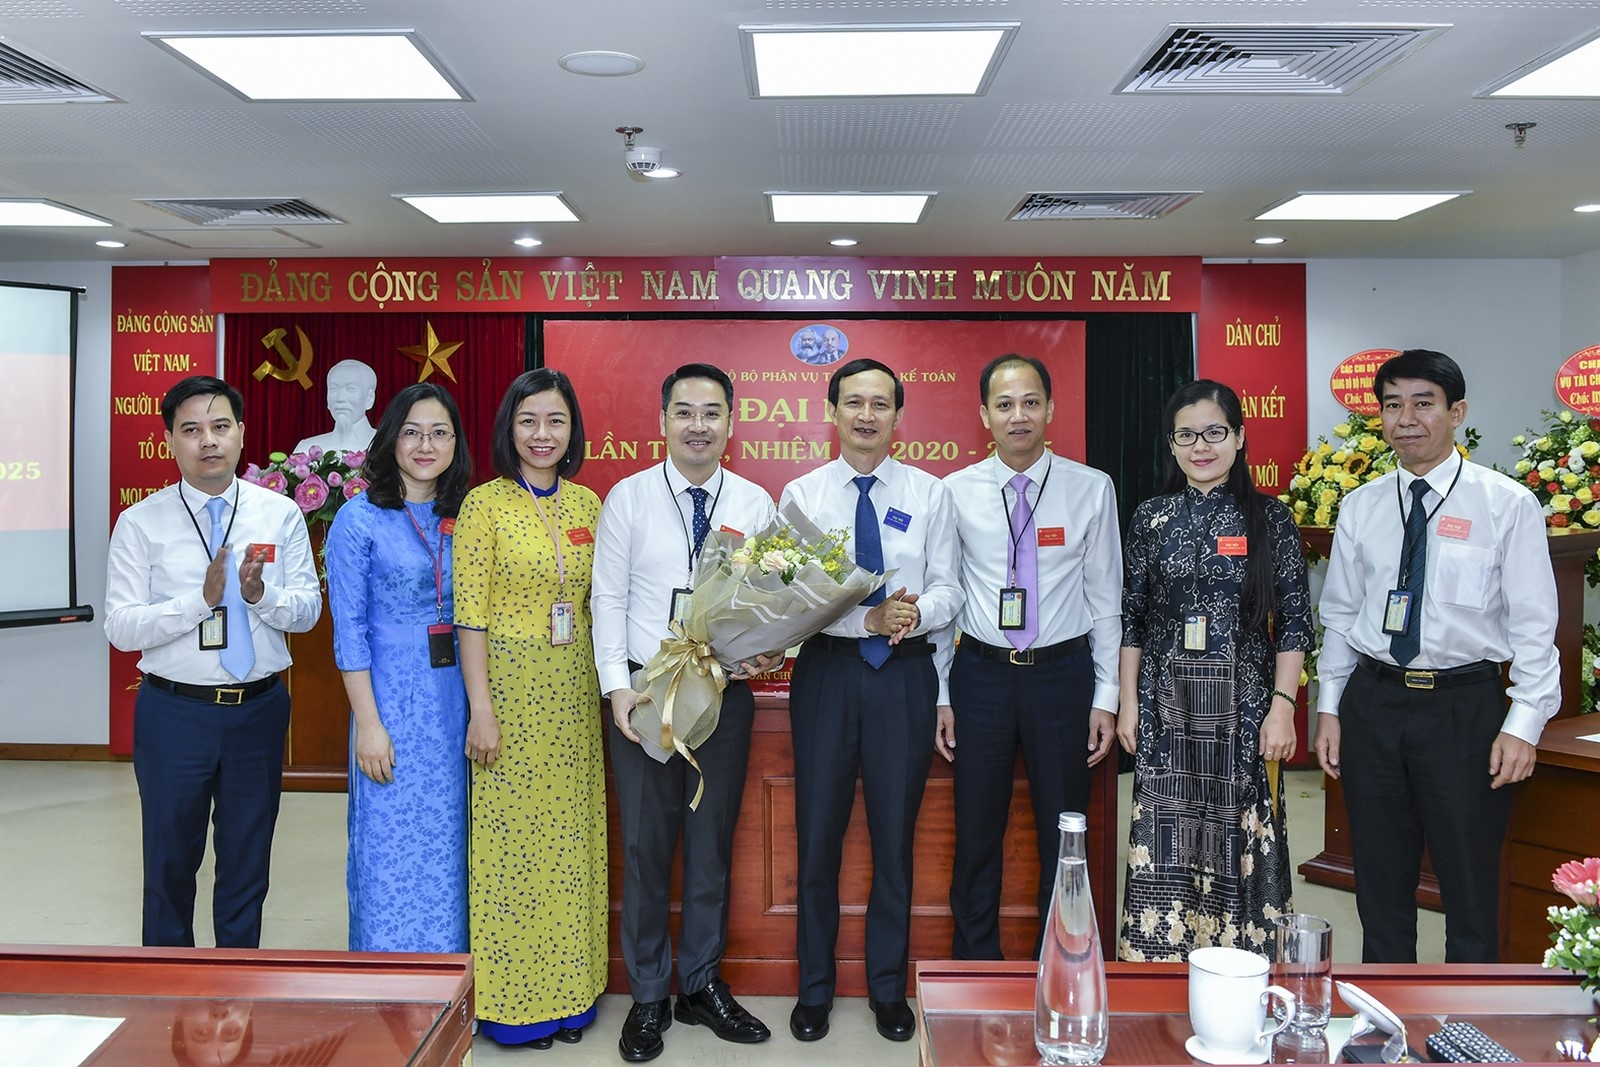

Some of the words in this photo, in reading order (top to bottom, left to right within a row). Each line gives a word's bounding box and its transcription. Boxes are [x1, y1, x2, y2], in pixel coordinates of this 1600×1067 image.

[239, 258, 333, 302] ĐẢNG
[348, 261, 440, 310] CỘNG
[456, 258, 523, 301] SẢN
[539, 261, 623, 308] VIỆT
[641, 270, 720, 300] NAM
[737, 268, 853, 302] QUANG
[867, 269, 957, 300] VINH
[972, 262, 1076, 302] MUÔN
[1091, 262, 1172, 301] NĂM
[117, 308, 151, 333] ĐẢNG
[153, 310, 187, 337] CỘNG
[189, 308, 214, 333] SẢN
[1226, 317, 1252, 346] DÂN
[1255, 315, 1281, 346] CHỦ
[133, 348, 160, 376] VIỆT
[163, 353, 190, 372] NAM
[741, 369, 758, 383] BỘ
[762, 369, 797, 384] PHẬN
[801, 372, 819, 384] VỤ
[900, 367, 917, 382] KẾ
[920, 369, 956, 382] TOÁN
[114, 392, 152, 415] NGƯỜI
[739, 398, 809, 428] ĐẠI
[1241, 389, 1258, 418] ÀN
[1261, 385, 1286, 418] KẾT
[138, 432, 155, 459] TỔ
[157, 441, 175, 459] CH
[584, 431, 639, 460] LẦN
[741, 435, 832, 464] NHIỆM
[891, 441, 959, 461] 2020
[1255, 458, 1279, 487] MỚI
